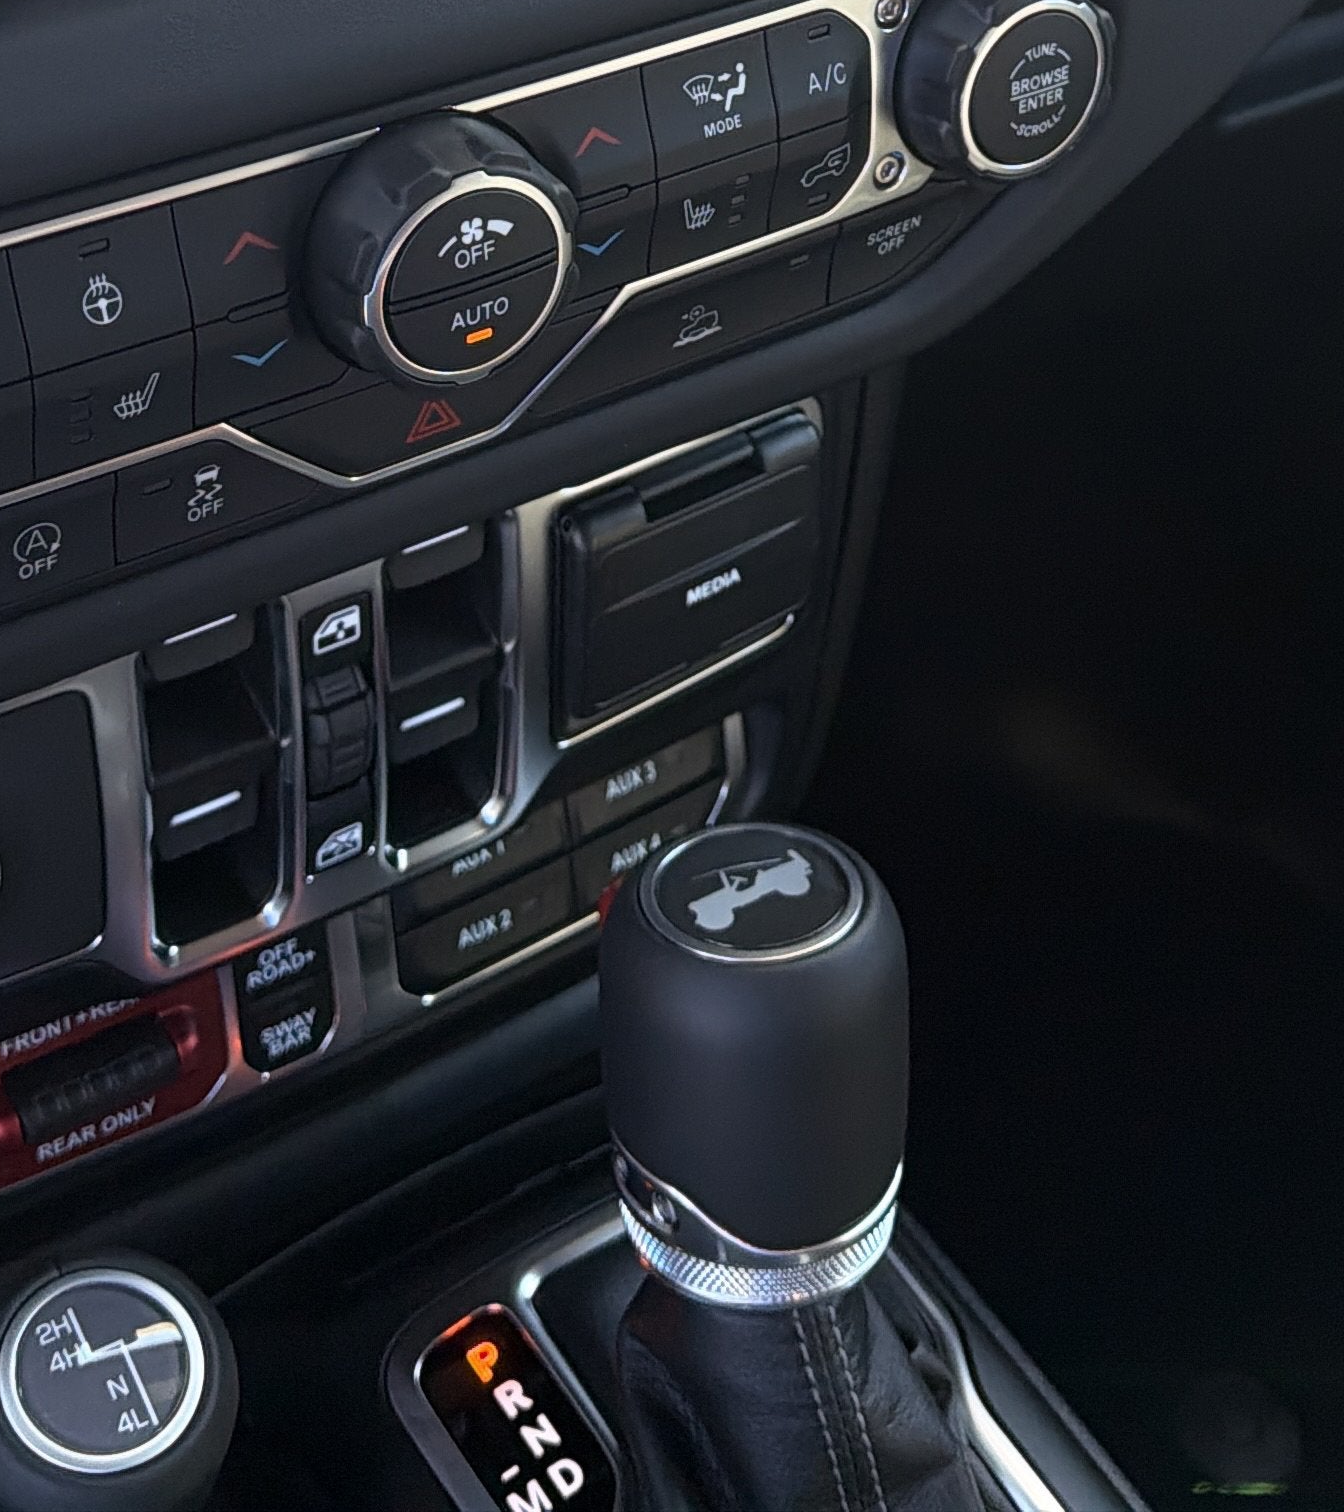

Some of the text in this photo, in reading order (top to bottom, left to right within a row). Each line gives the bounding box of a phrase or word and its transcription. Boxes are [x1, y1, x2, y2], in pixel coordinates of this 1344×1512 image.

[1024, 42, 1058, 62] TUNE
[808, 63, 848, 95] A/C
[1011, 64, 1070, 97] BROWSE
[1018, 88, 1064, 115] ENTER
[703, 114, 744, 138] MODE
[1016, 113, 1062, 138] SCROLL
[867, 215, 922, 248] SCREEN
[878, 233, 907, 256] OFF
[454, 239, 496, 270] OFF
[450, 295, 510, 332] AUTO
[186, 498, 225, 524] OFF
[18, 553, 58, 581] OFF
[685, 567, 742, 607] MEDIA
[605, 759, 656, 802] AUX 3
[458, 908, 513, 950] AUX 2
[257, 937, 298, 969] OFF
[260, 1006, 317, 1044] SWAY
[267, 1026, 312, 1062] BAR
[37, 1095, 157, 1163] REAR ONLY
[35, 1315, 72, 1348] 2H
[49, 1342, 80, 1374] 4H
[465, 1341, 499, 1383] P
[106, 1375, 131, 1400] N
[493, 1378, 534, 1420] R
[117, 1408, 149, 1434] 4L
[520, 1413, 562, 1460] N
[547, 1458, 585, 1501] D
